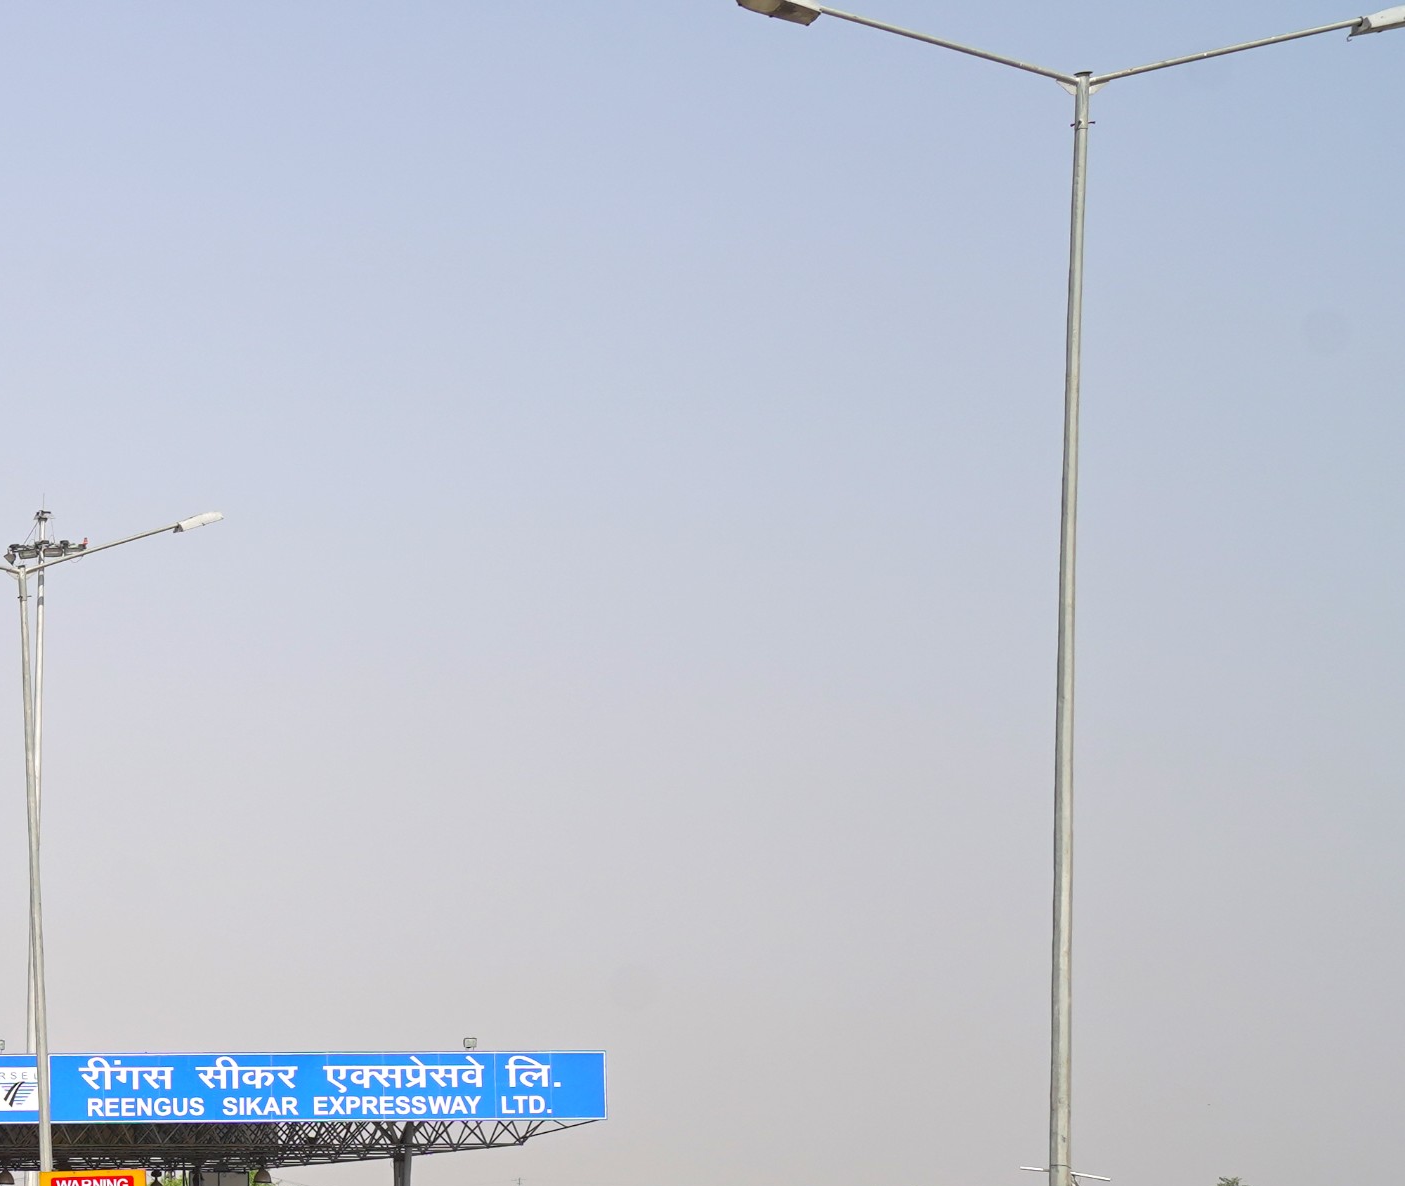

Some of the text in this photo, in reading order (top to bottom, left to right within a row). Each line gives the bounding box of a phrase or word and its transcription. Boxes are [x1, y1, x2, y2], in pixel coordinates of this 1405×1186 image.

[79, 1056, 561, 1093] रींगस सीकर एक्सप्रेसवे लि.
[87, 1095, 552, 1117] REENGUS SIKAR EXPRESSWAY LTD.
